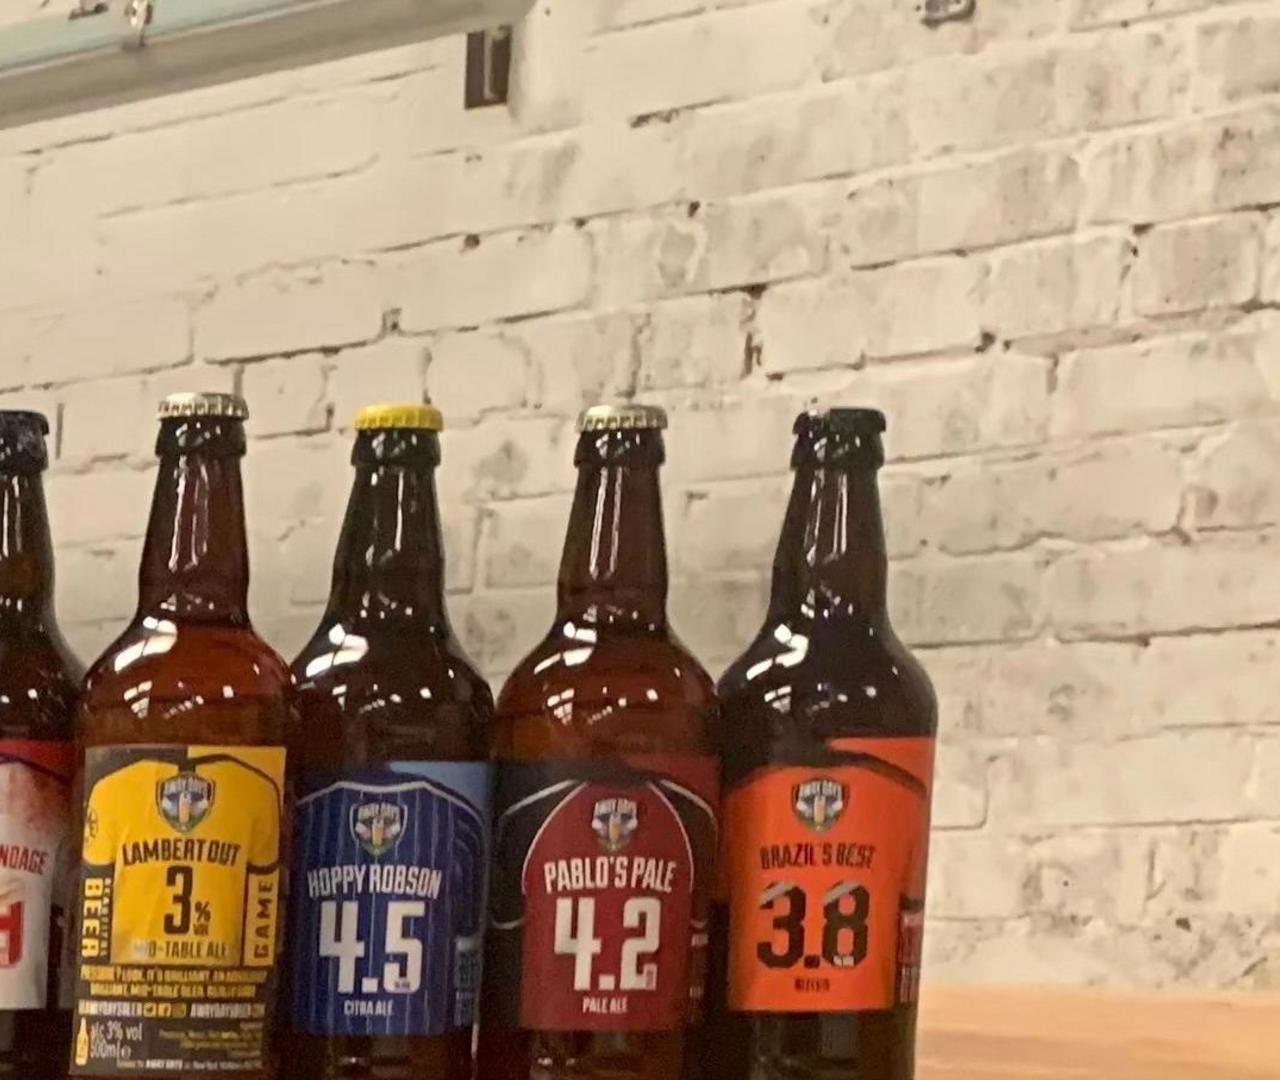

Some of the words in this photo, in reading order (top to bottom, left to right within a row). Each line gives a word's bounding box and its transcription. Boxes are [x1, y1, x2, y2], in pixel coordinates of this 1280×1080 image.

[122, 838, 206, 867] LAMBERT
[207, 839, 242, 867] OUT
[760, 843, 832, 869] BRAZIL'S
[836, 845, 876, 869] BEST
[307, 865, 366, 898] HOPPY
[369, 864, 443, 899] ROBSON
[544, 857, 628, 893] PABLO'S
[631, 857, 677, 893] PALE
[81, 877, 104, 958] BEER
[163, 865, 193, 935] 3
[254, 880, 273, 959] GAME
[756, 880, 871, 969] 3.8
[132, 939, 201, 959] ID-TABLE
[319, 901, 425, 994] 4.5
[554, 896, 662, 991] 4.2
[583, 997, 608, 1013] PALE
[609, 997, 628, 1013] ALE
[126, 1022, 143, 1041] vol
